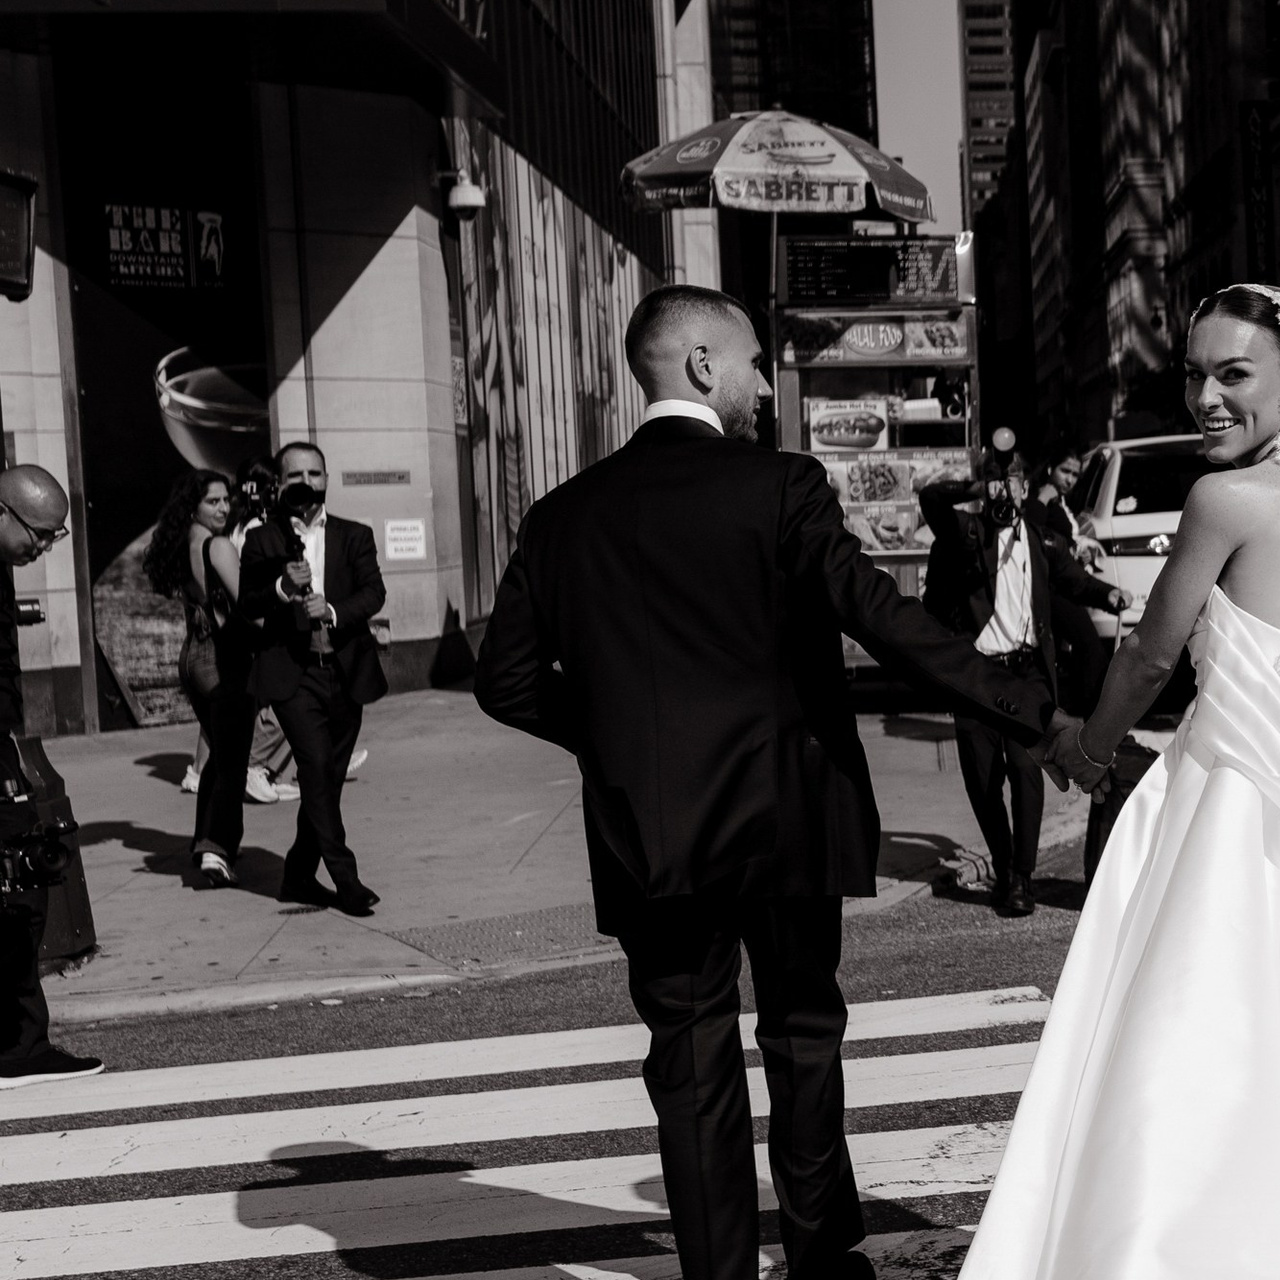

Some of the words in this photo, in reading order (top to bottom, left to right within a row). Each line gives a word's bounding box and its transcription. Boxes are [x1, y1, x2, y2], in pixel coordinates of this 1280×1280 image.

[741, 140, 826, 154] SABRETT
[724, 178, 859, 202] SABRETT
[104, 203, 181, 231] THE
[109, 227, 182, 254] BAR
[109, 252, 184, 266] DOWNSTAIRS
[119, 263, 184, 278] KITCHEN
[845, 323, 876, 349] HALAL
[879, 323, 903, 347] FOOD
